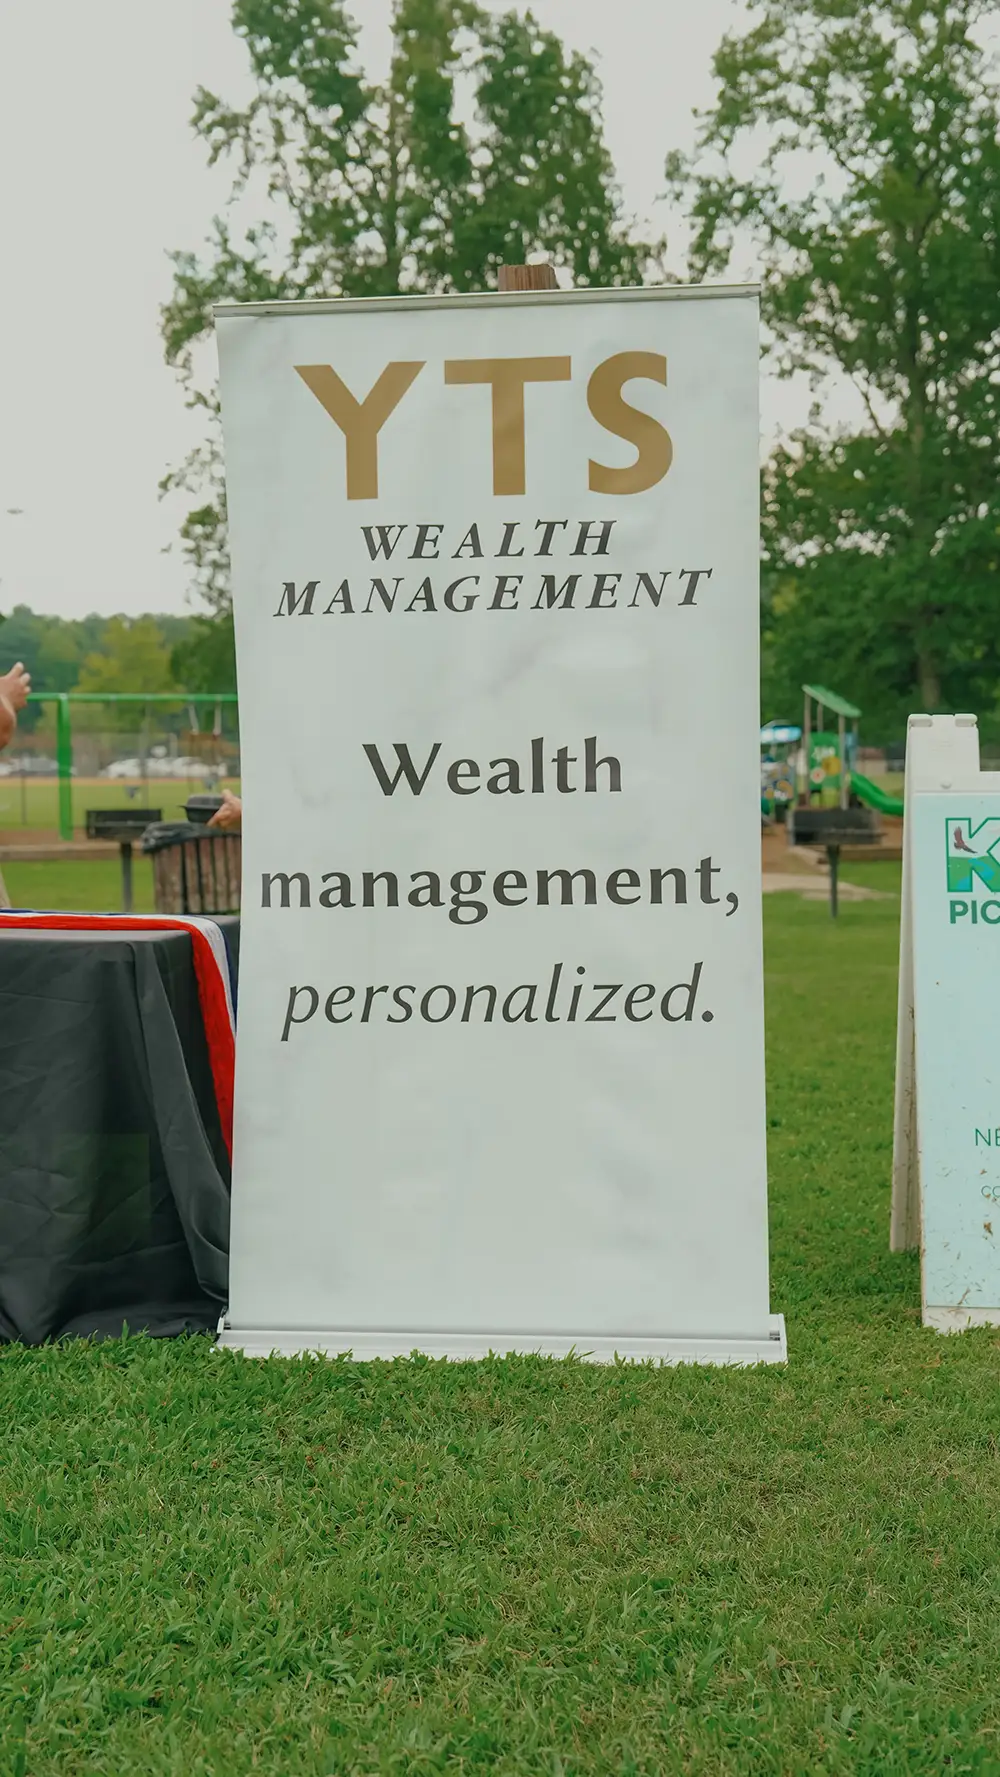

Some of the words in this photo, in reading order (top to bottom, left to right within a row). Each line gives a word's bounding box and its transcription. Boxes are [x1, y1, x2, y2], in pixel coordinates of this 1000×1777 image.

[293, 350, 673, 500] YTS
[360, 519, 617, 560] WEALTH
[273, 568, 713, 616] MANAGEMENT
[362, 736, 622, 796] Wealth
[261, 856, 739, 925] management,
[281, 962, 715, 1041] personalized.
